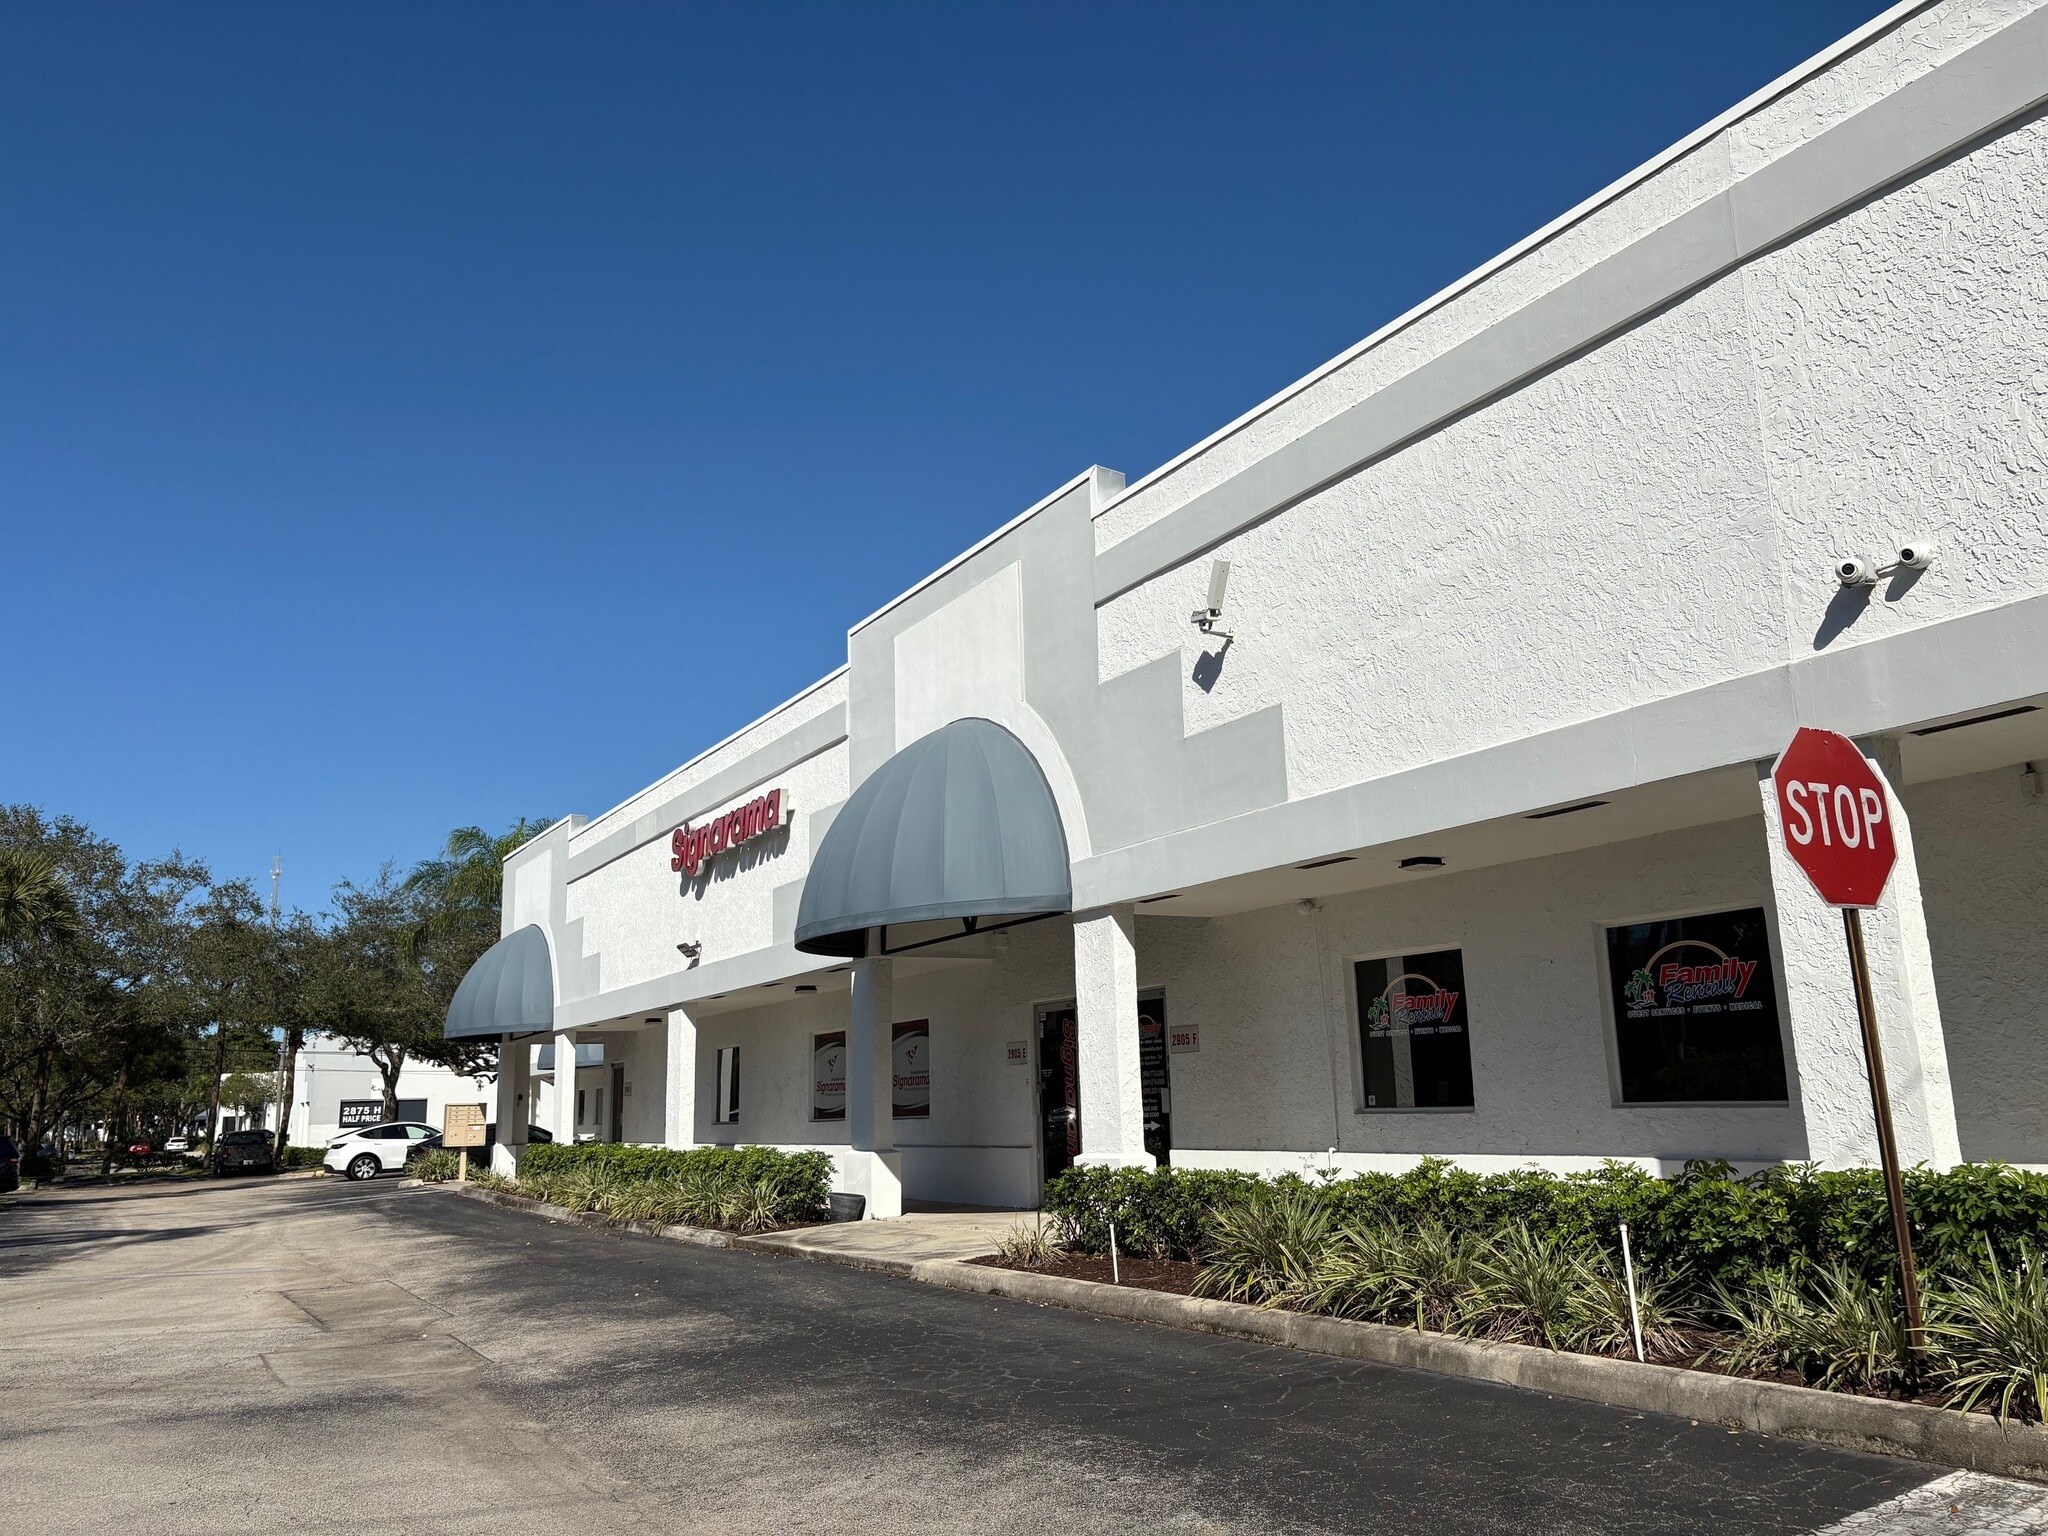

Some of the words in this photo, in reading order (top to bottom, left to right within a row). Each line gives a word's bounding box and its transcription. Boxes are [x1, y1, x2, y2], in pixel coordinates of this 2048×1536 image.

[1786, 779, 1883, 850] STOP
[671, 788, 781, 877] Signarama
[1659, 956, 1757, 998] Family
[1392, 988, 1459, 1023] Family
[1663, 978, 1736, 1007] Rentals
[1626, 1009, 1650, 1019] GUEST
[1650, 1006, 1686, 1017] SERVICES
[1692, 1003, 1722, 1014] EVENTS
[1728, 1000, 1764, 1012] MEDICAL
[1008, 1048, 1021, 1059] 2905
[1172, 1033, 1190, 1046] 2905
[1192, 1032, 1197, 1044] F
[1060, 1018, 1079, 1162] Signaram
[342, 1115, 360, 1123] HALF
[361, 1114, 381, 1122] PRICE
[343, 1106, 370, 1115] 2875
[373, 1106, 382, 1114] H
